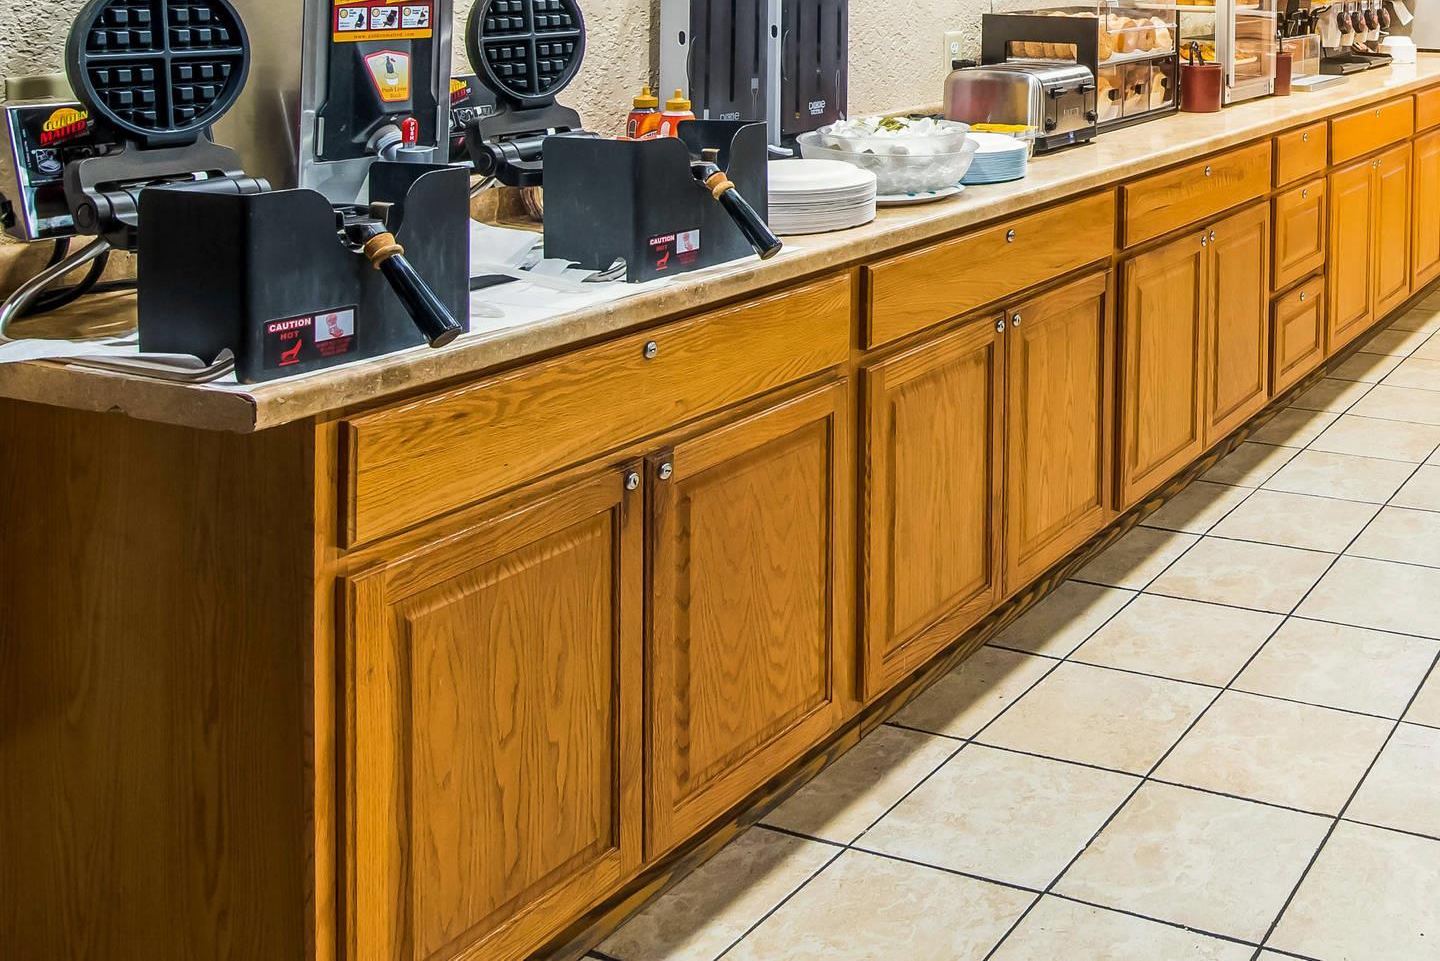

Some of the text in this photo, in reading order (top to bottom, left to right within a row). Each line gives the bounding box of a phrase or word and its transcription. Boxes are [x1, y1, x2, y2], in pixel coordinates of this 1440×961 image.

[43, 110, 88, 131] GOLDEN
[41, 119, 87, 143] MALTED
[650, 234, 675, 246] CAUTION
[269, 318, 312, 332] CAUTION
[280, 330, 300, 341] HOT
